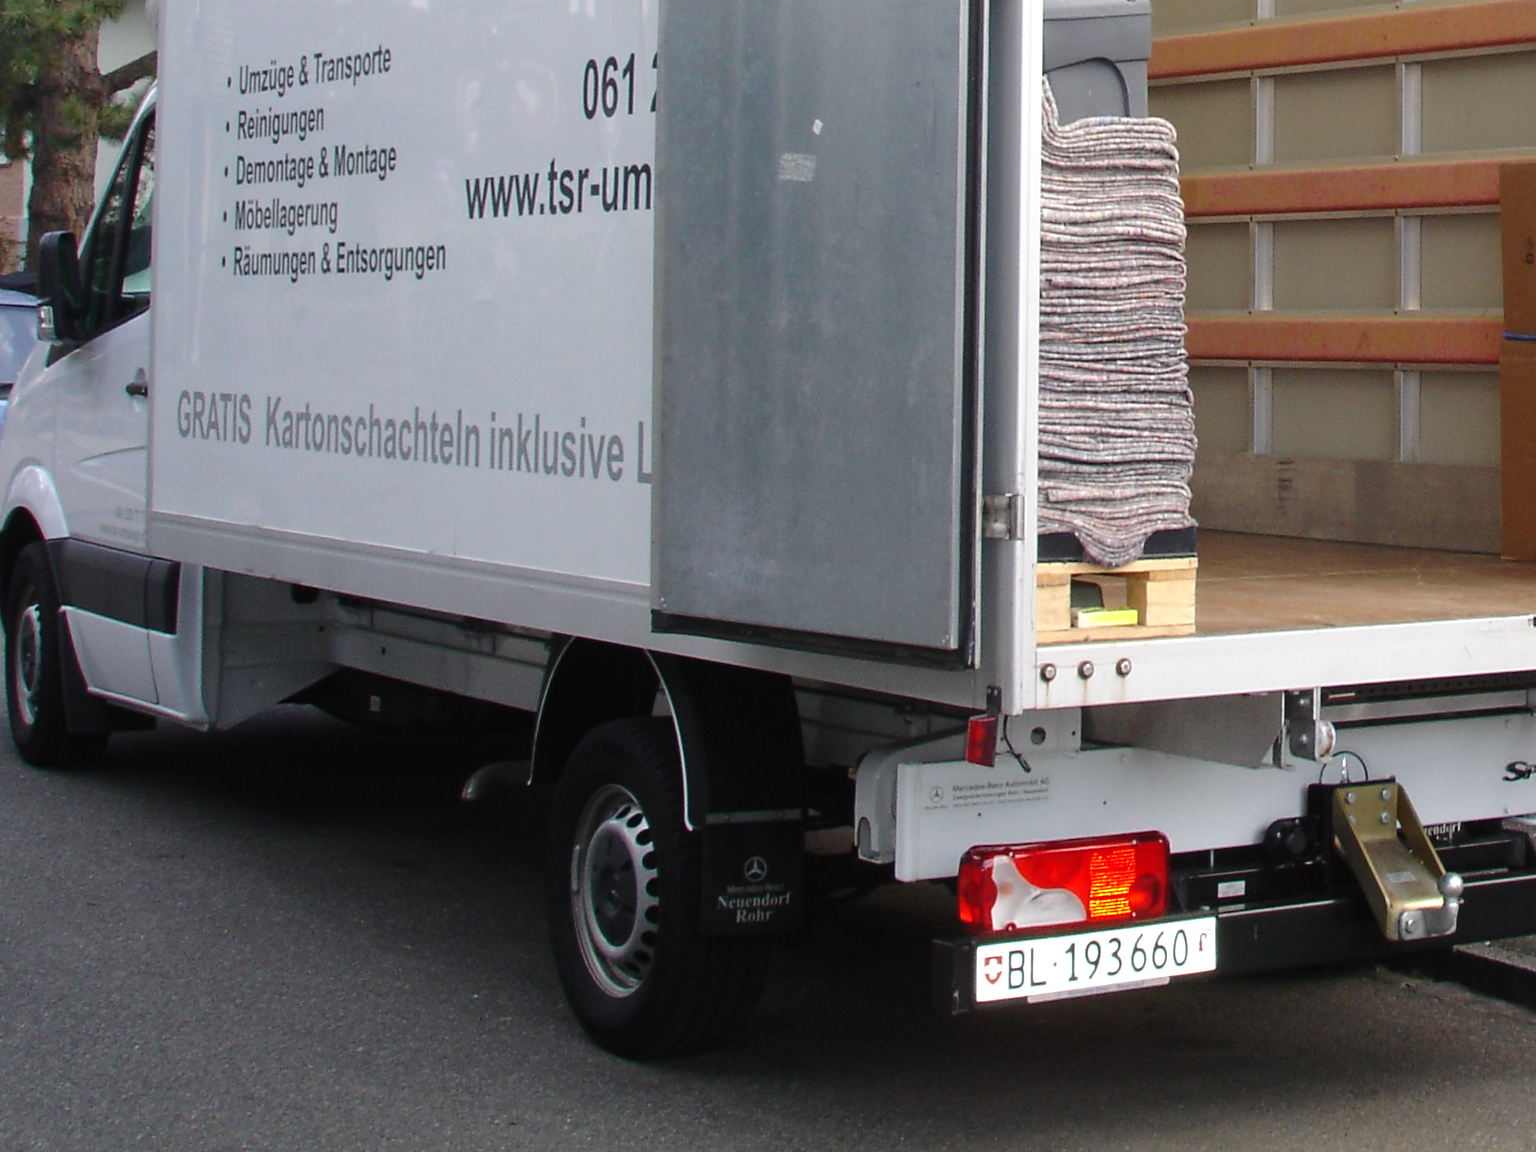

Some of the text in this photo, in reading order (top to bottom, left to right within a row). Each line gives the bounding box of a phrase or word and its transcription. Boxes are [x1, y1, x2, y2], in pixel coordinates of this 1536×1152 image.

[238, 44, 392, 97] Umzüge & Transporte
[582, 52, 635, 120] 061
[237, 106, 324, 145] Reinigungen
[236, 144, 397, 189] Demontage & Montage
[465, 157, 652, 220] www.tsr-um
[234, 198, 338, 236] Möbellagerung
[233, 241, 447, 283] Räumungen & Entsorgungen
[177, 389, 252, 444] GRATIS
[265, 395, 480, 468] Kartonschachteln
[489, 411, 624, 482] inklusive
[718, 891, 792, 909] Neuendorf
[736, 908, 773, 923] Rohr
